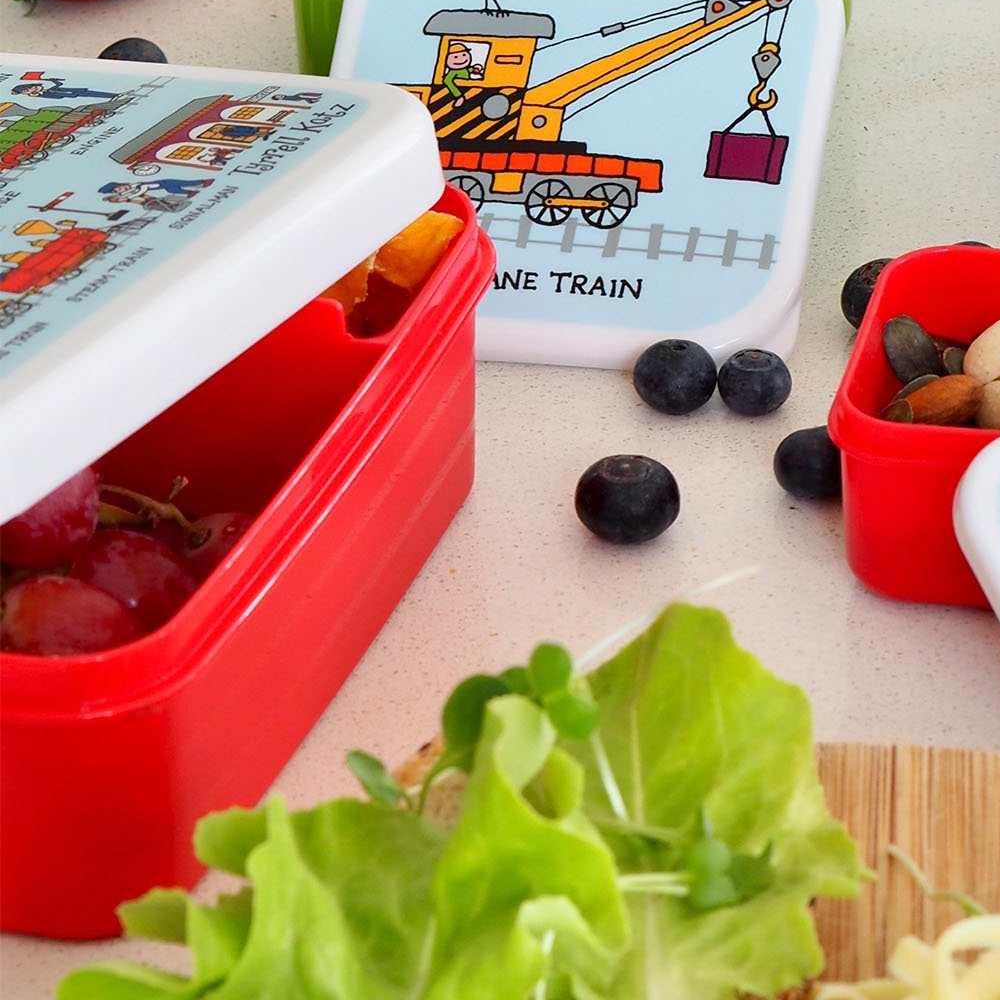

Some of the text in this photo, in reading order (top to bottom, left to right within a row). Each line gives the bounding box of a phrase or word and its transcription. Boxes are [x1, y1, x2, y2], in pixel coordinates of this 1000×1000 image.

[69, 125, 125, 156] ENGINE
[227, 102, 356, 176] Tyrrell Katz
[168, 184, 240, 230] SIGNALMAN
[549, 271, 644, 300] TRAIN
